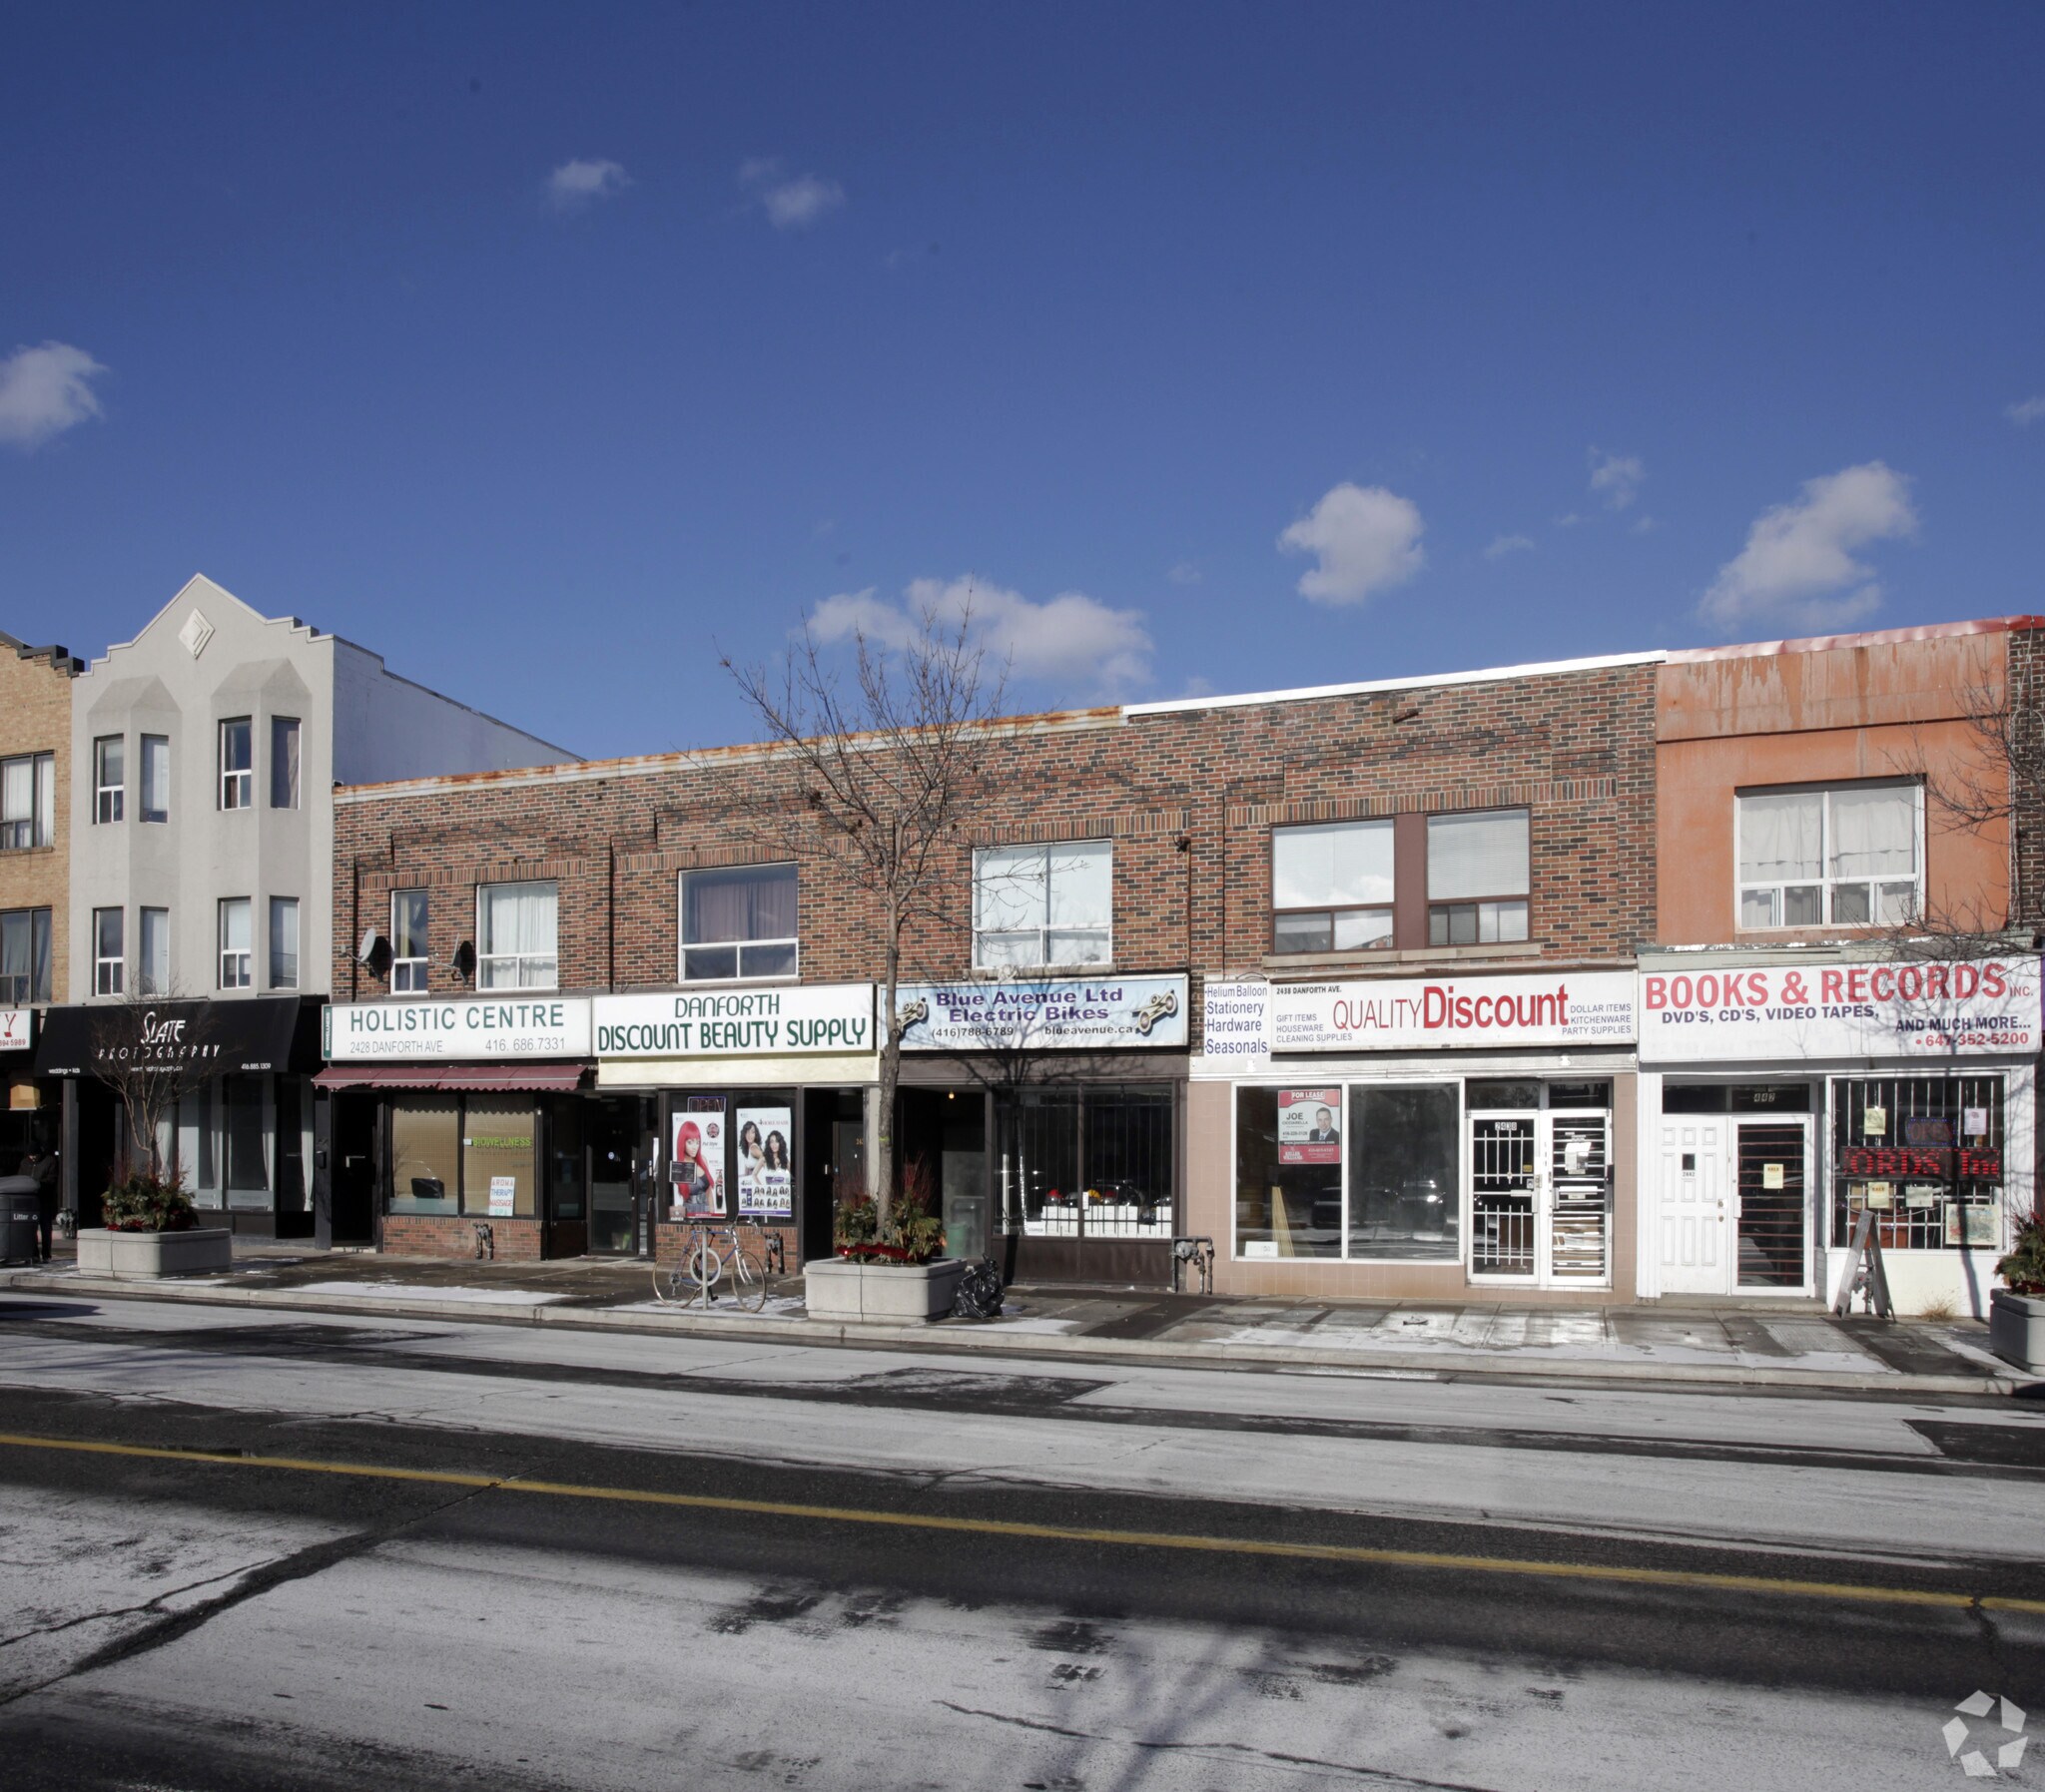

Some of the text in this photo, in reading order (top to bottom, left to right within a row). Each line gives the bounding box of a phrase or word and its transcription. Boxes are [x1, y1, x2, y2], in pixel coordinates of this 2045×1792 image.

[1236, 984, 1267, 997] Balloon
[1647, 963, 2034, 1010] BOOKS & RECORDS INC.
[936, 988, 1123, 1006] Blue Avenue Ltd
[675, 994, 780, 1018] DANFORTH
[949, 1006, 1109, 1022] Electric Bikes
[1333, 983, 1569, 1030] QUALITY Discount
[1570, 1003, 1632, 1013] DOLLAR ITEMS
[1662, 1004, 1879, 1024] DVD'S, CD'S, VIDEO TAPES,
[350, 1003, 564, 1032] HOLISTIC CENTRE
[1570, 1014, 1632, 1024] KITCHENWARE
[1896, 1015, 2031, 1032] AND MUCH MORE...
[140, 1011, 186, 1044] SLATE
[598, 1017, 867, 1051] DISCOUNT BEAUTY SUPPLY
[931, 1025, 1133, 1039] (416)788-6789 blueavenue.ca
[1276, 1023, 1324, 1032] HOUSEWARE
[1562, 1025, 1632, 1035] PARTY SUPPLIES
[1276, 1032, 1353, 1043] CLEANING SUPPLIES
[1925, 1032, 2029, 1046] 647-352-5200
[349, 1039, 445, 1053] 2428 DANFORTH AVE.
